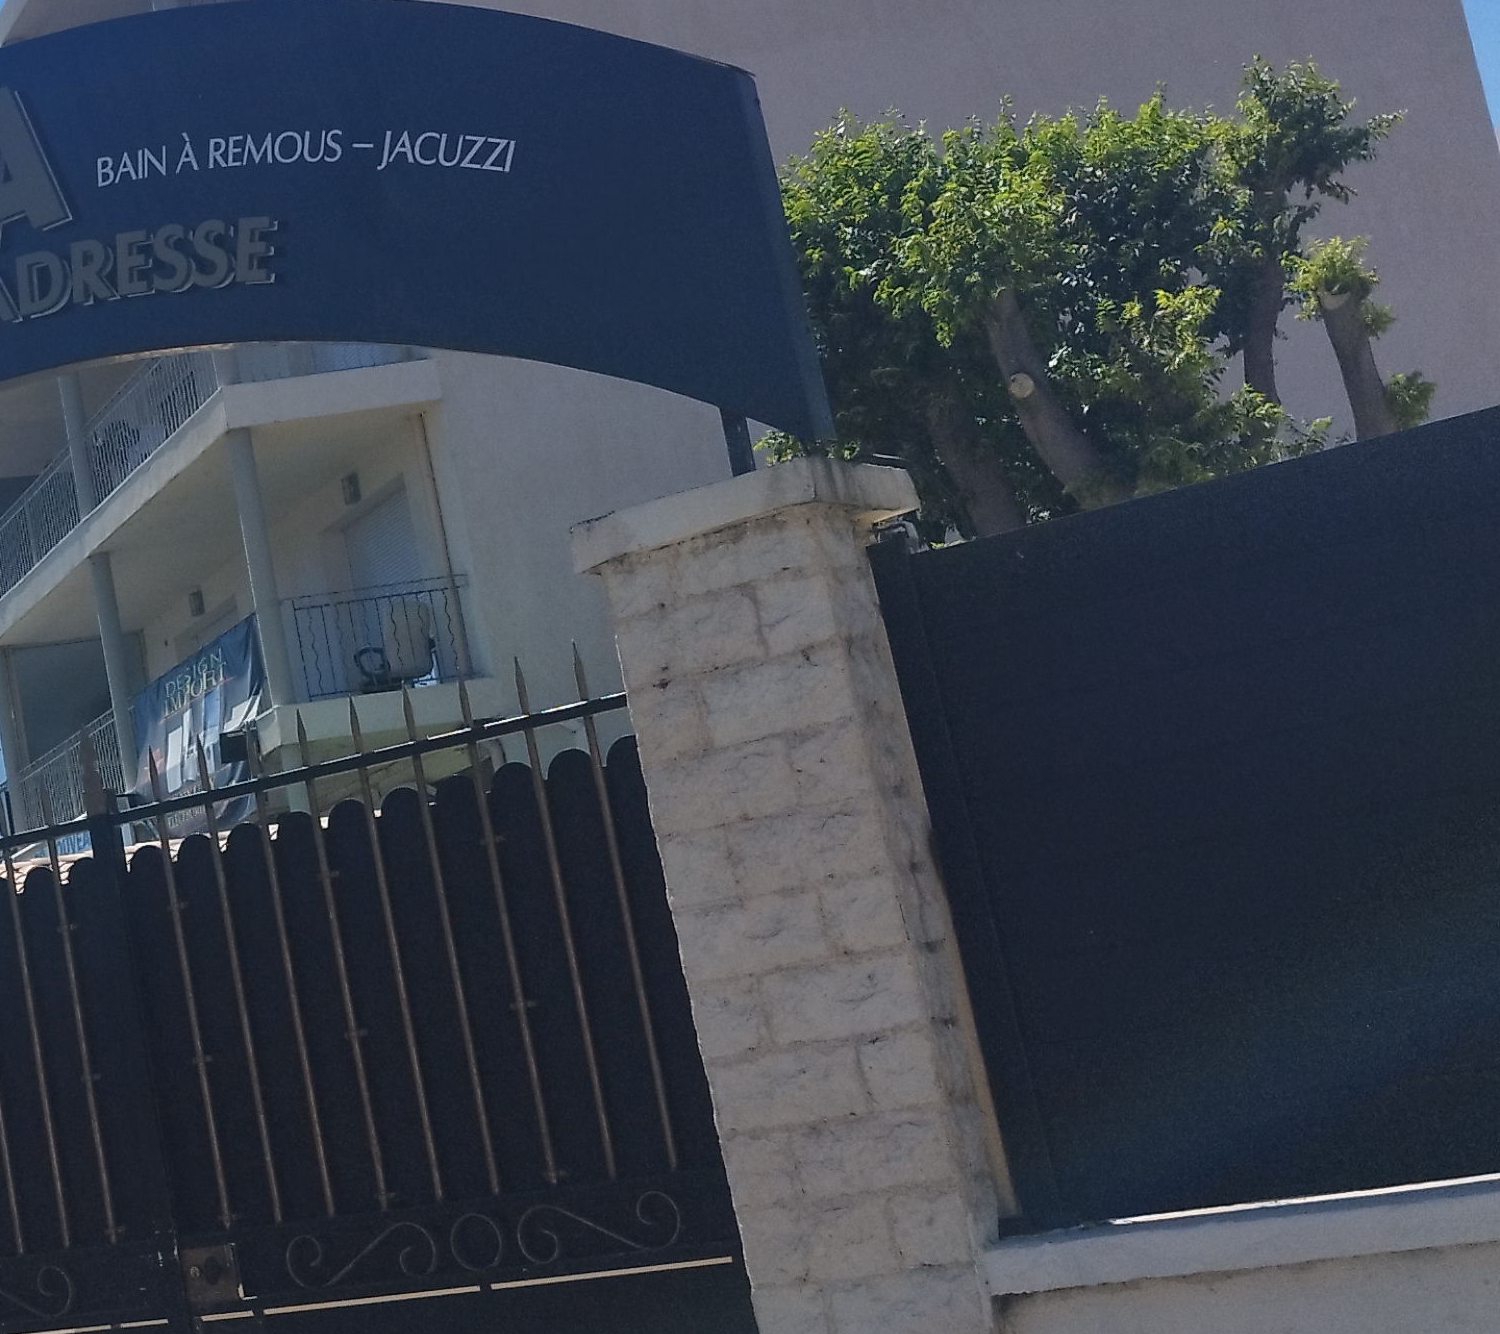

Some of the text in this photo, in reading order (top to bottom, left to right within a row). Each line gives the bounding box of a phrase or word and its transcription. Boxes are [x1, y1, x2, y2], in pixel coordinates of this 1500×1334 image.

[97, 146, 167, 187] BAIN
[175, 133, 200, 173] À
[207, 129, 343, 169] REMOUS
[376, 130, 517, 172] JACUZZI
[165, 647, 222, 698] DESIGN
